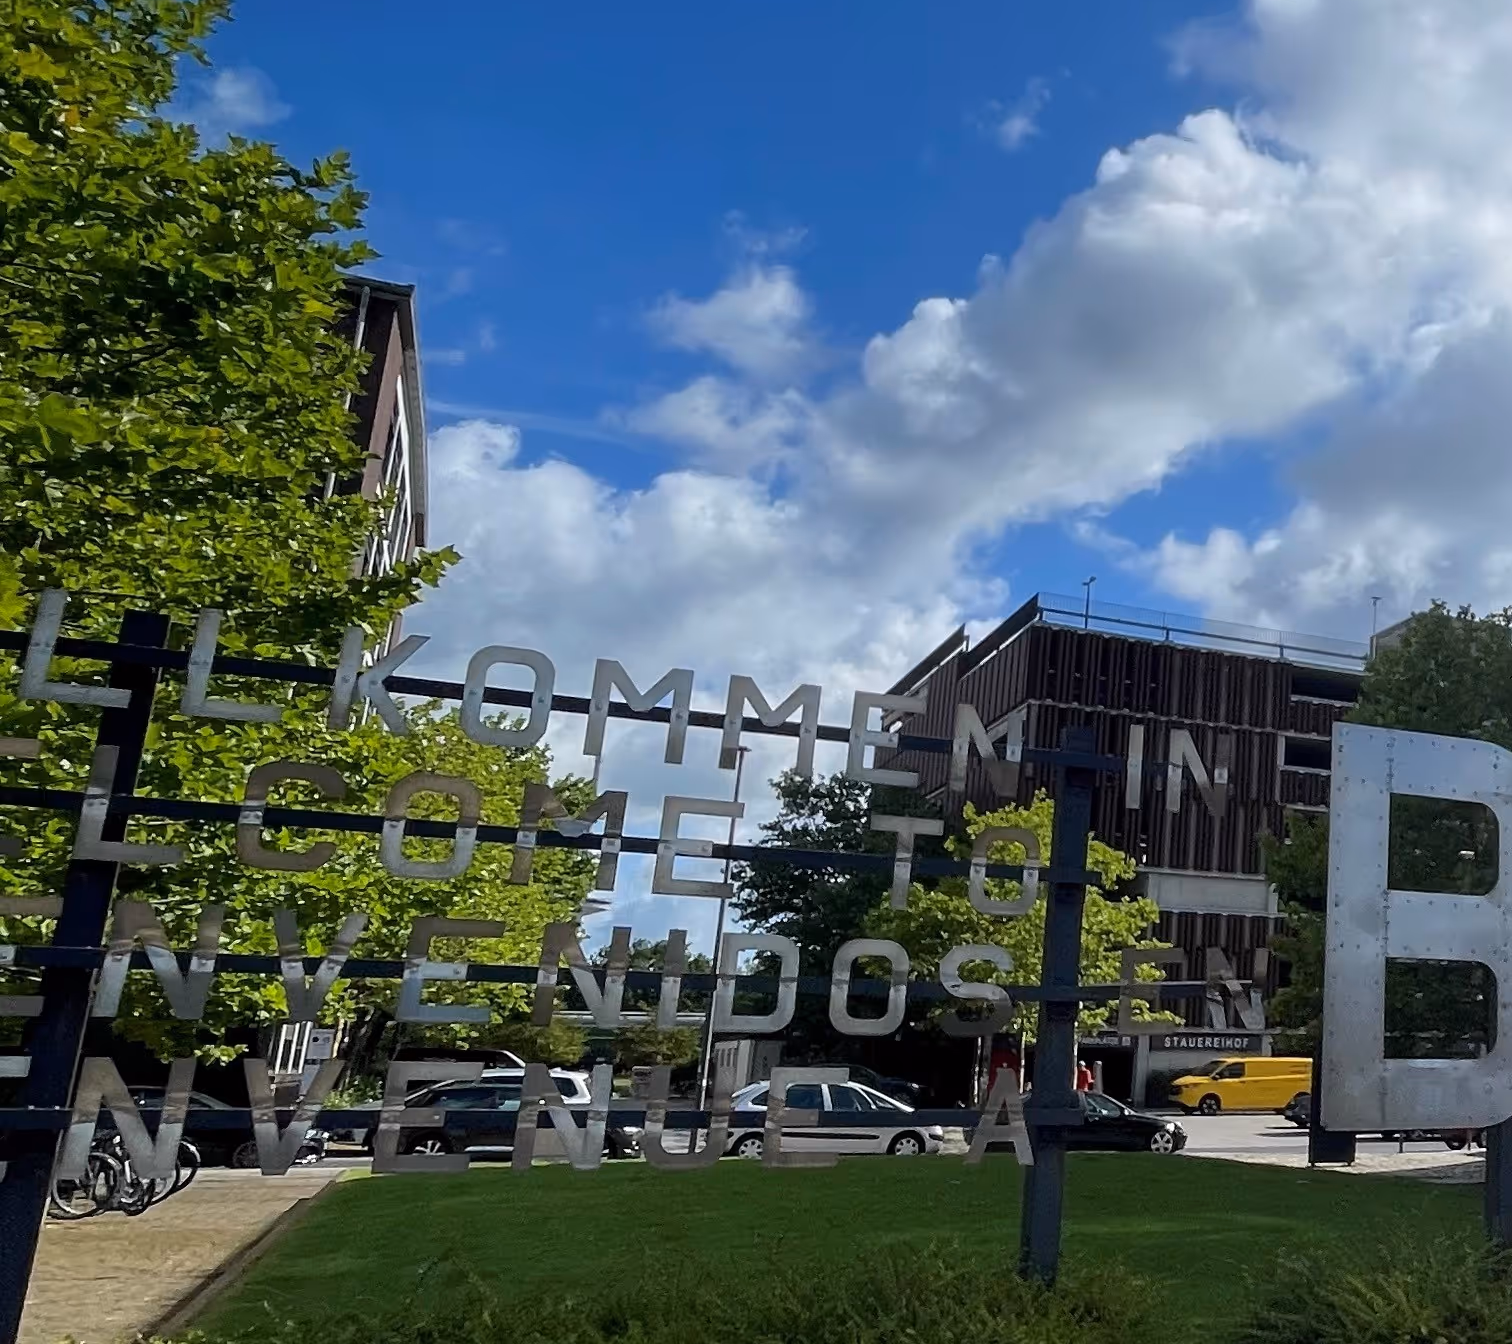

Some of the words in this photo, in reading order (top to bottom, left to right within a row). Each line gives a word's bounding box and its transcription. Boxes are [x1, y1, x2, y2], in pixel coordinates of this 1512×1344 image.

[1125, 723, 1231, 817] IN
[870, 815, 1040, 916] TO
[1117, 947, 1270, 1035] EN
[1163, 1035, 1250, 1049] STAUEREIHOF
[0, 1056, 850, 1182] NVENUE
